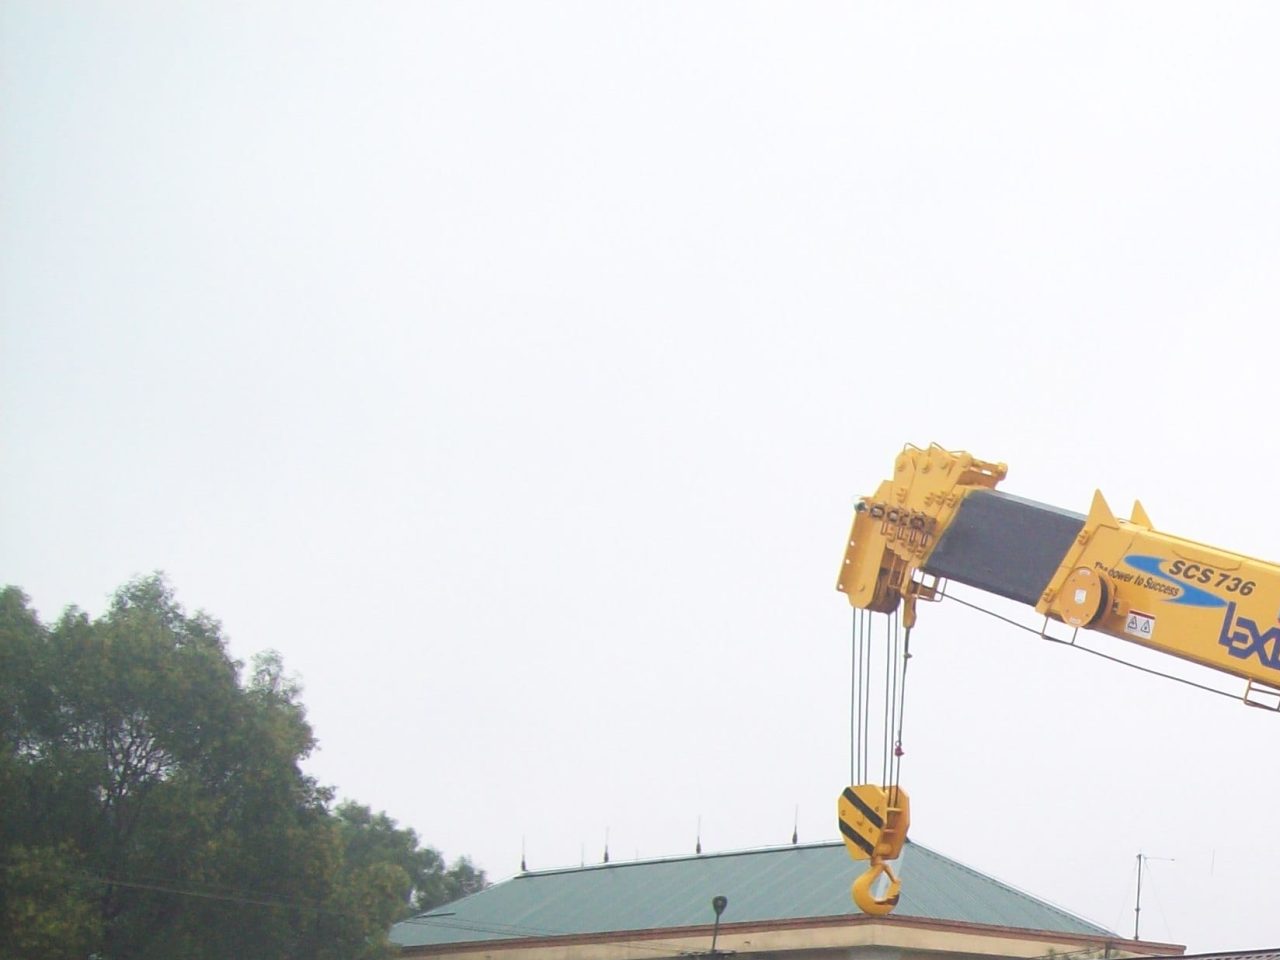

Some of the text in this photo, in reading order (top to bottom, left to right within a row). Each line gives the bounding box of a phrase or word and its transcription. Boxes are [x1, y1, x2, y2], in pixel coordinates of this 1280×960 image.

[1134, 575, 1145, 586] to
[1144, 577, 1180, 597] Success
[1168, 560, 1256, 596] SCS 736
